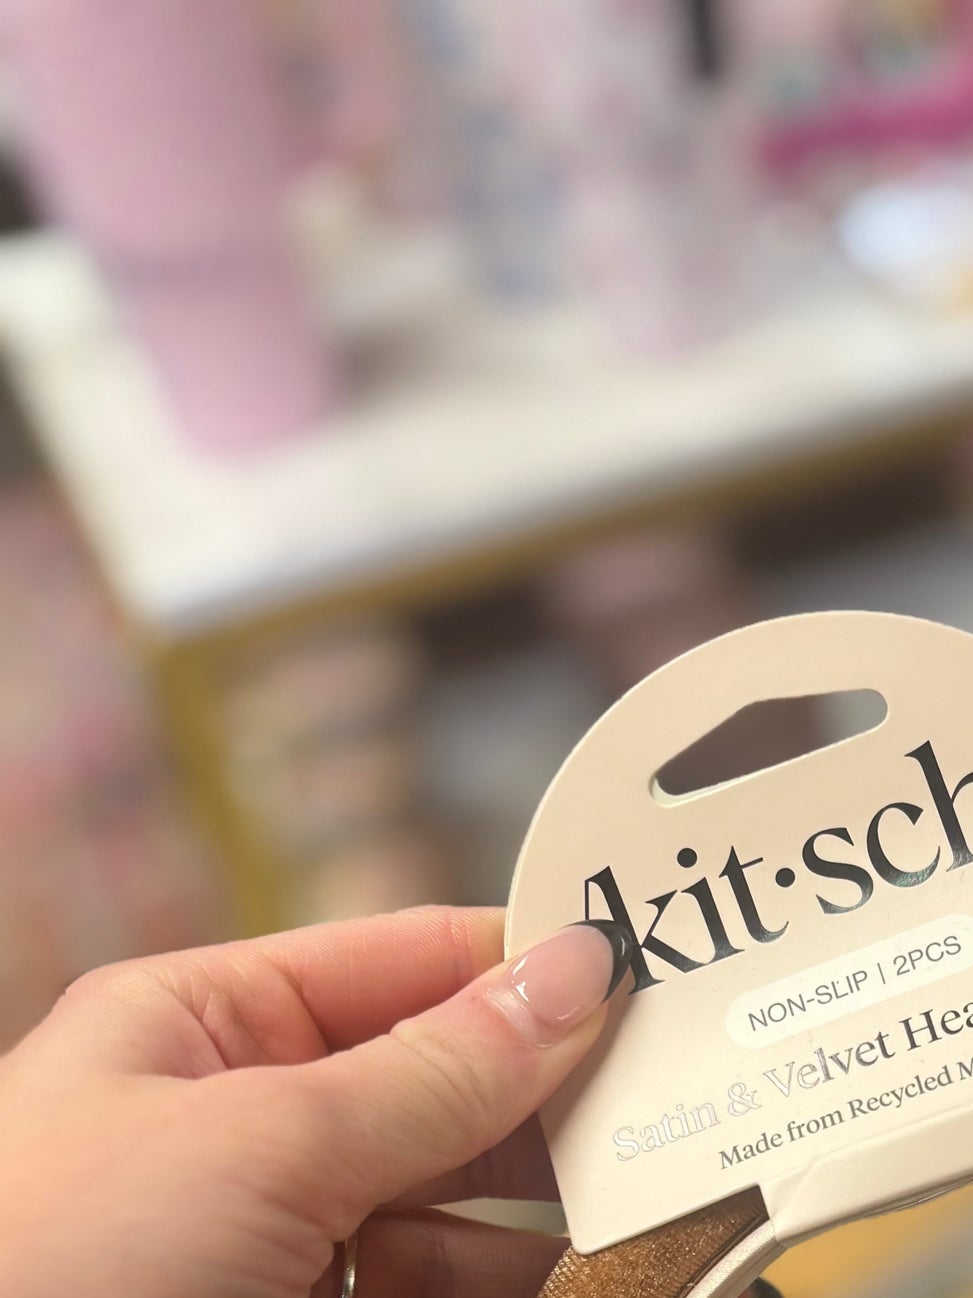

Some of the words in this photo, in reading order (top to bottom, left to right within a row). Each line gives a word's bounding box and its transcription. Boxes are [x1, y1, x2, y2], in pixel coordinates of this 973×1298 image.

[748, 970, 868, 1031] NON-SLIP
[893, 936, 962, 976] 2PCS
[612, 1100, 721, 1162] Satin
[727, 1081, 762, 1117] &
[763, 1031, 896, 1098] Velvet
[718, 1132, 784, 1169] Made
[785, 1110, 845, 1143] from
[847, 1065, 953, 1119] Recycled
